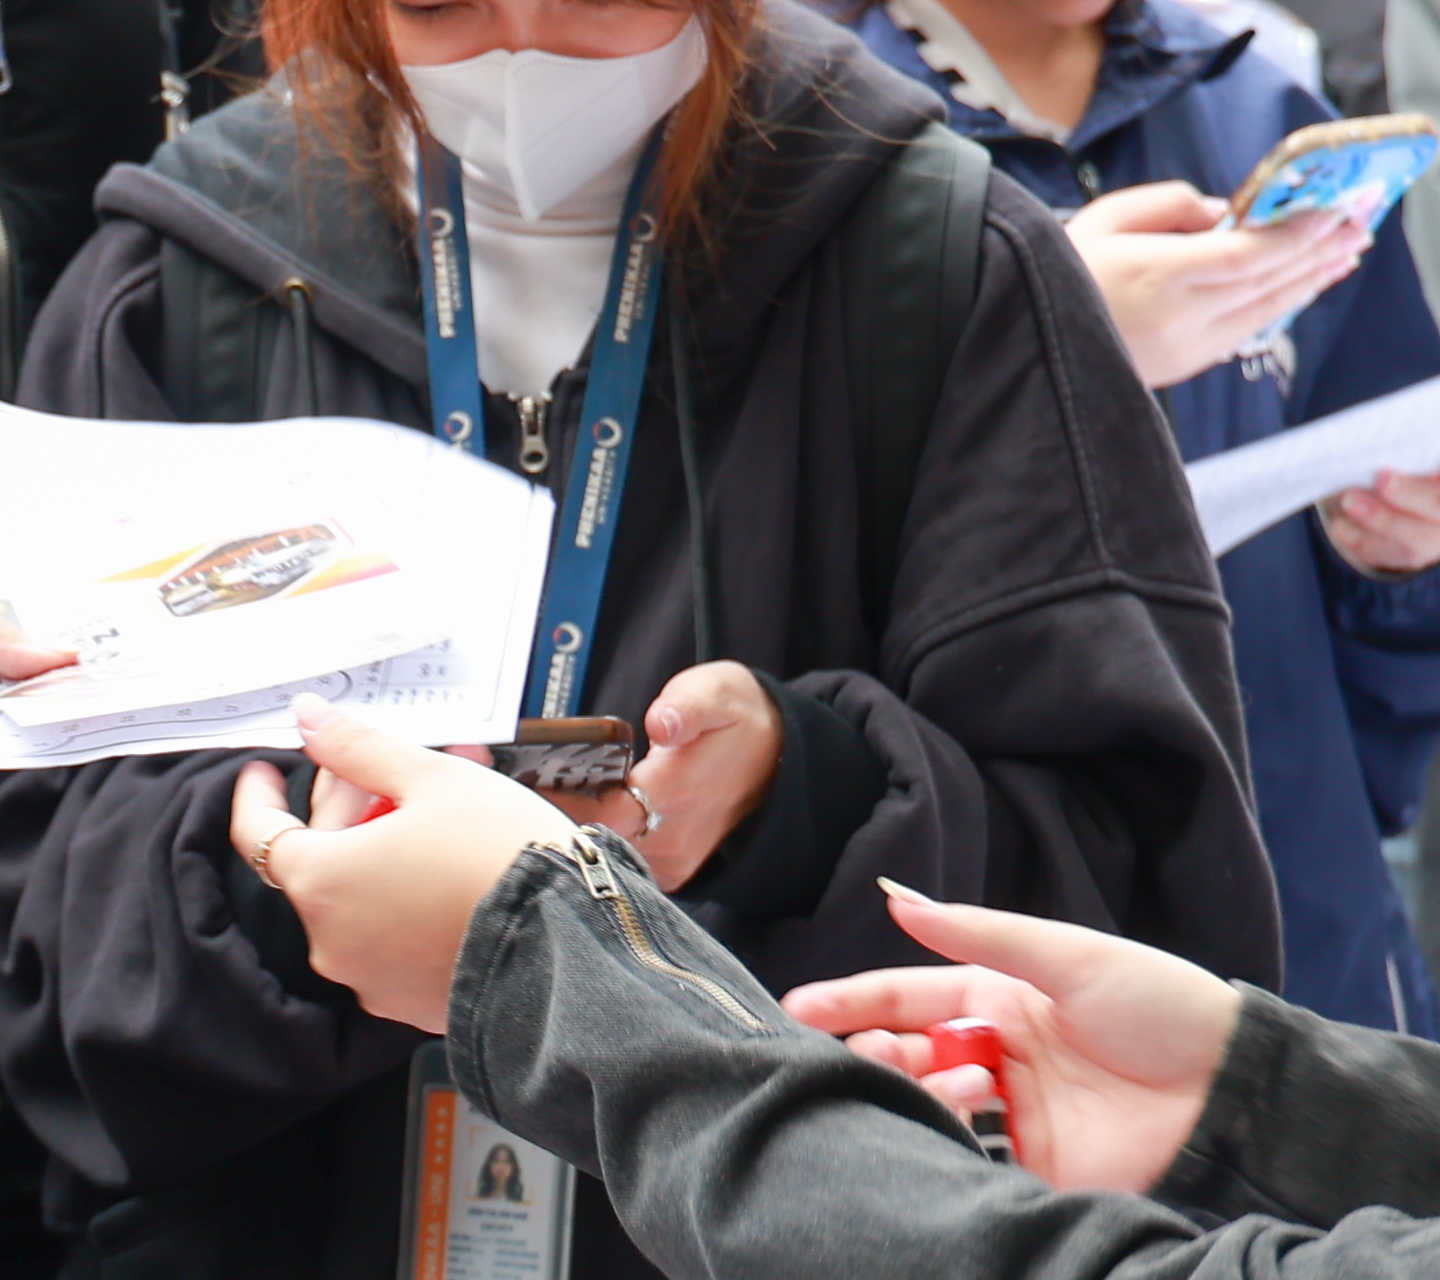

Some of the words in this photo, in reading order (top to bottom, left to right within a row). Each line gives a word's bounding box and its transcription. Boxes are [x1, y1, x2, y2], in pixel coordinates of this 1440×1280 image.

[430, 237, 457, 338] PHENIKAA
[614, 242, 644, 343] PHENIKAA
[575, 446, 608, 548] PHENIKAA
